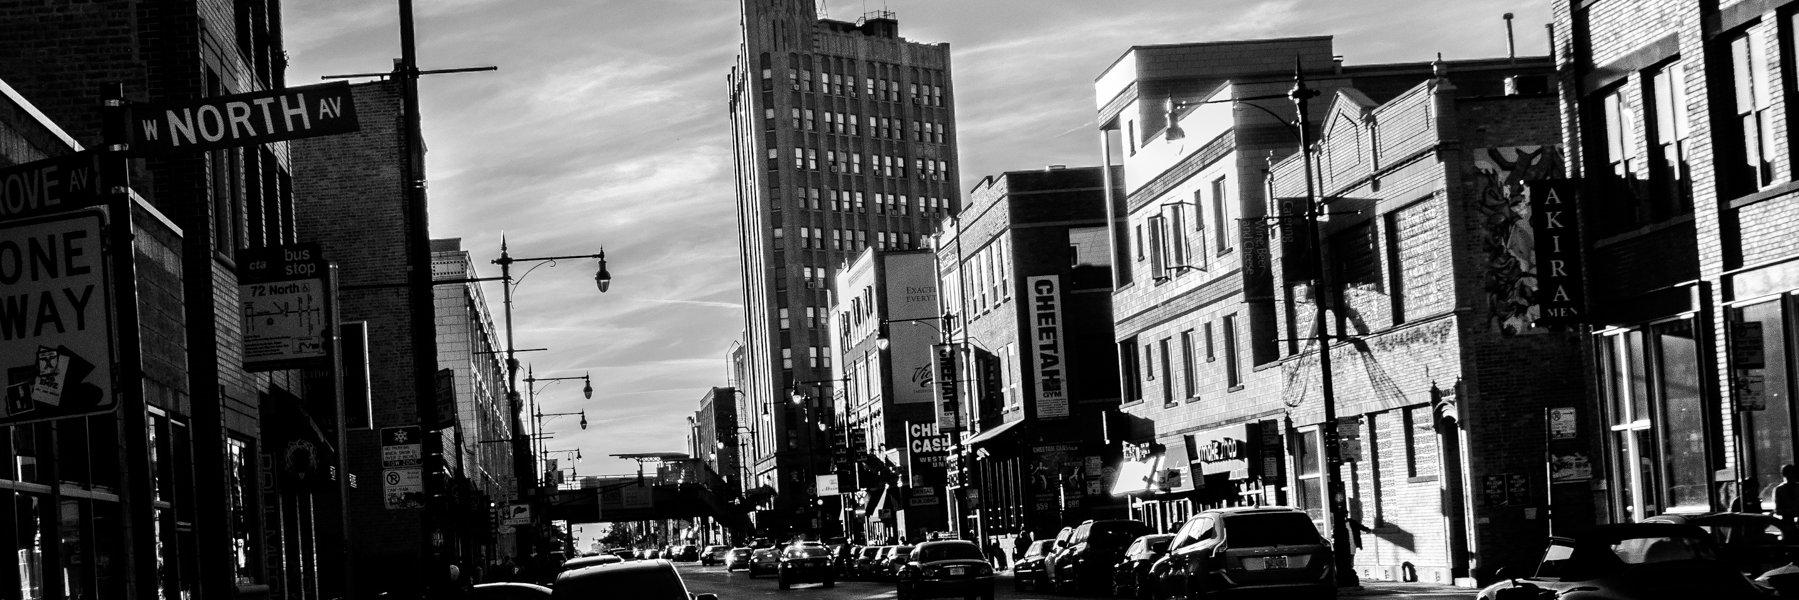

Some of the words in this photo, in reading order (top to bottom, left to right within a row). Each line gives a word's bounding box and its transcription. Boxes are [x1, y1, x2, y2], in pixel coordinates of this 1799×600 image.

[142, 118, 159, 142] W
[165, 92, 312, 148] NORTH
[318, 96, 342, 121] AV
[69, 166, 89, 193] AV
[1242, 219, 1254, 239] and
[1282, 200, 1294, 243] Catering
[0, 229, 91, 286] ONE
[284, 248, 311, 262] bus
[1544, 186, 1571, 302] AKIRA
[248, 259, 267, 271] cta
[284, 262, 316, 277] stop
[1243, 240, 1255, 276] Cheese
[1256, 247, 1268, 269] Beer
[250, 285, 266, 297] 72
[269, 283, 300, 296] North
[0, 284, 95, 341] WAY
[1547, 306, 1578, 318] MEN
[1034, 279, 1062, 392] CHEETAH
